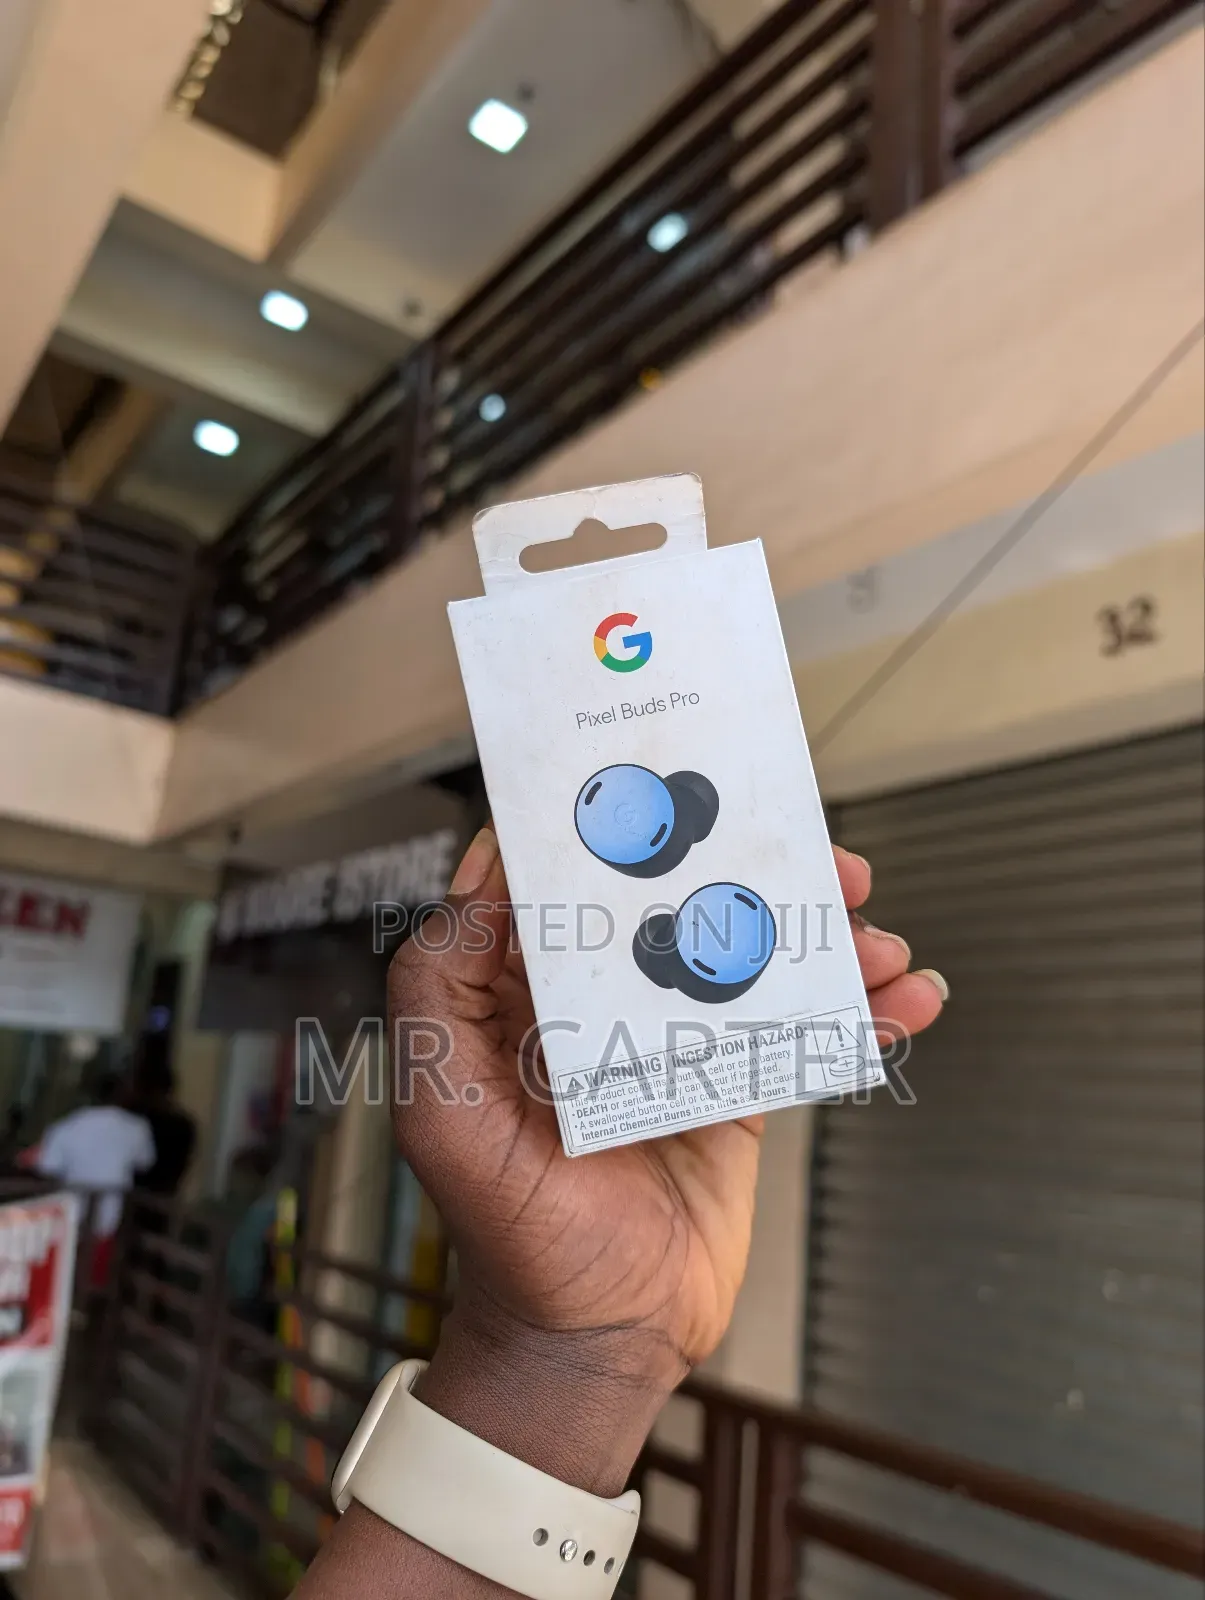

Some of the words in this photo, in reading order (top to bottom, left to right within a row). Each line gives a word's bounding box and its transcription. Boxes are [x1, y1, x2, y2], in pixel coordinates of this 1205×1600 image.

[593, 612, 653, 673] G
[576, 706, 617, 729] Pixel
[621, 696, 667, 720] Buds
[669, 692, 700, 709] Pro
[569, 1096, 589, 1109] This
[591, 1087, 626, 1105] product
[628, 1077, 667, 1094] contains
[669, 1076, 675, 1084] a
[677, 1068, 706, 1083] button
[708, 1064, 724, 1075] cell
[727, 1061, 735, 1070] or
[738, 1056, 757, 1069] coin
[760, 1049, 793, 1063] battery.
[584, 1056, 662, 1088] WARNING
[671, 1039, 745, 1068] INGESTION
[748, 1025, 809, 1050] HAZARD:
[610, 1102, 620, 1111] or
[622, 1092, 656, 1108] serious
[657, 1087, 682, 1100] injury
[684, 1082, 700, 1093] can
[703, 1076, 728, 1088] occur
[731, 1071, 737, 1081] if
[739, 1062, 781, 1082] ingested.
[579, 1121, 587, 1131] A
[589, 1110, 636, 1129] swallowed
[638, 1102, 668, 1116] button
[669, 1095, 686, 1110] cell
[688, 1094, 698, 1104] or
[700, 1089, 720, 1103] coin
[721, 1082, 753, 1097] battery
[755, 1077, 772, 1088] can
[773, 1071, 800, 1084] cause
[581, 1124, 617, 1141] Internal
[620, 1113, 663, 1132] Chemical
[664, 1108, 691, 1122] Burns
[693, 1105, 702, 1115] in
[705, 1102, 715, 1112] as
[717, 1095, 738, 1110] little
[740, 1094, 751, 1103] as
[752, 1091, 758, 1100] 2
[760, 1085, 790, 1099] hours.
